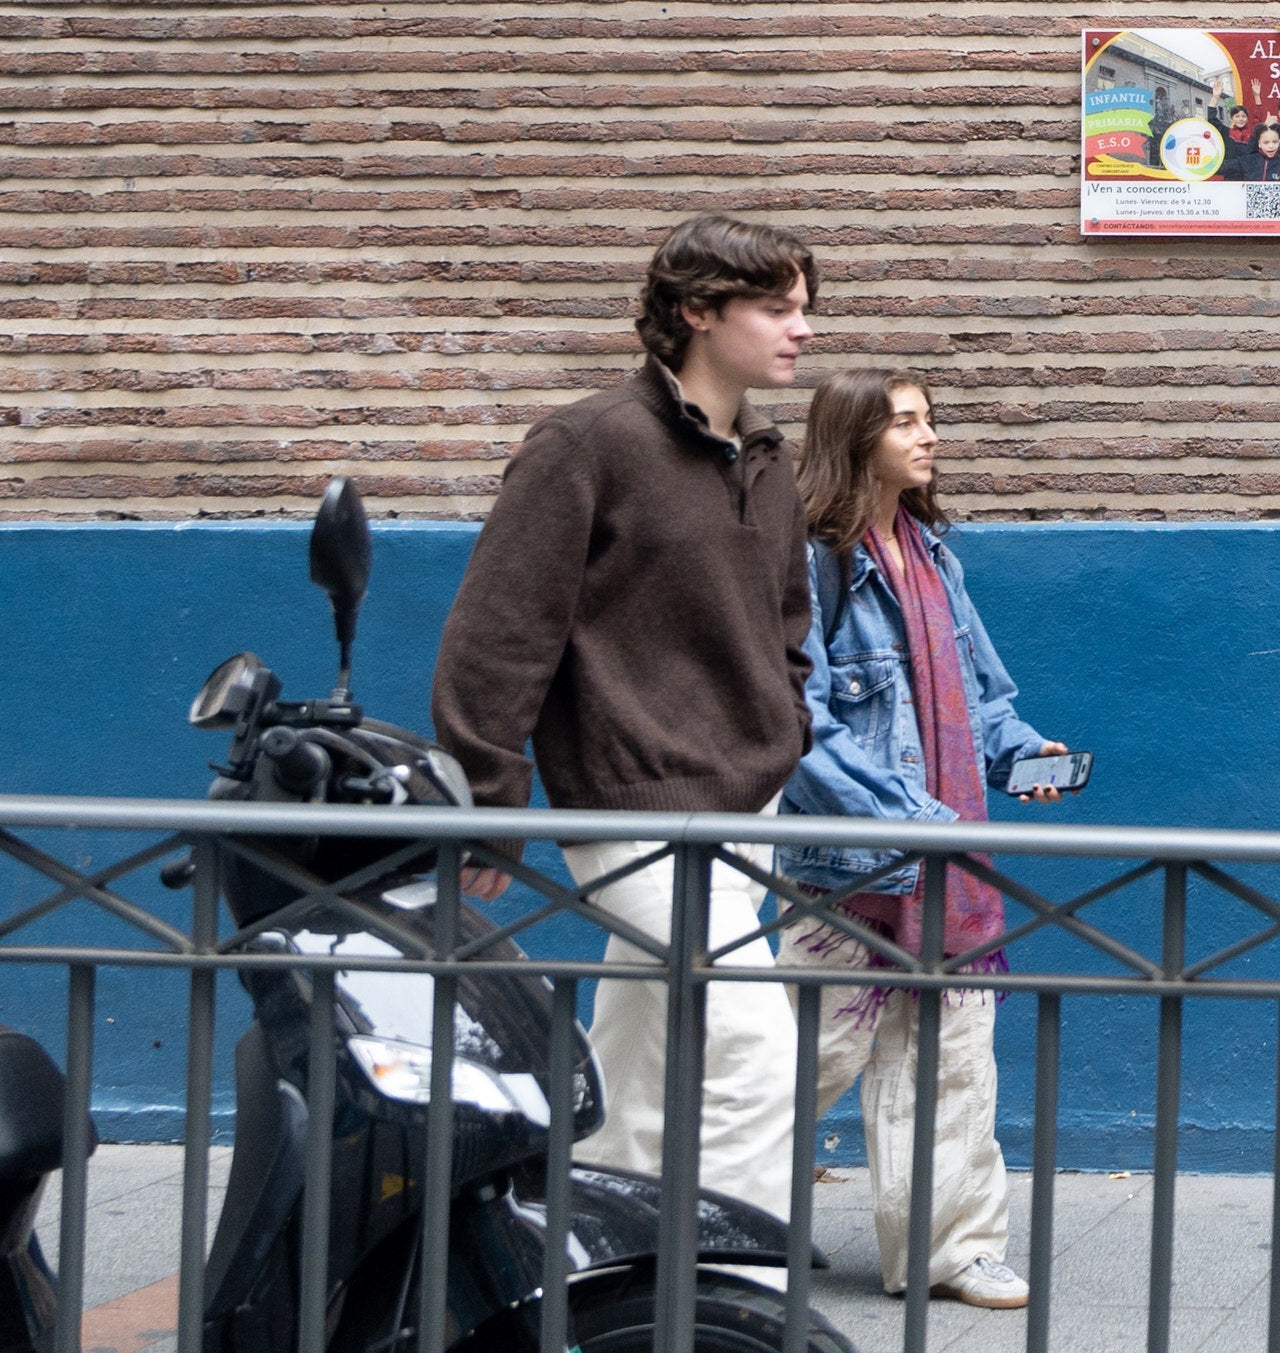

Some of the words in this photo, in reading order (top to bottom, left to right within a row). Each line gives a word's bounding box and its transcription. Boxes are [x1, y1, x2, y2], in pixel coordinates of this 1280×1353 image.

[1090, 93, 1147, 106] INFANTIL
[1088, 118, 1144, 129] PRIMARIA
[1097, 137, 1131, 149] E.S.O
[1087, 183, 1113, 196] ¡Ven
[1126, 184, 1191, 194] conocernos!
